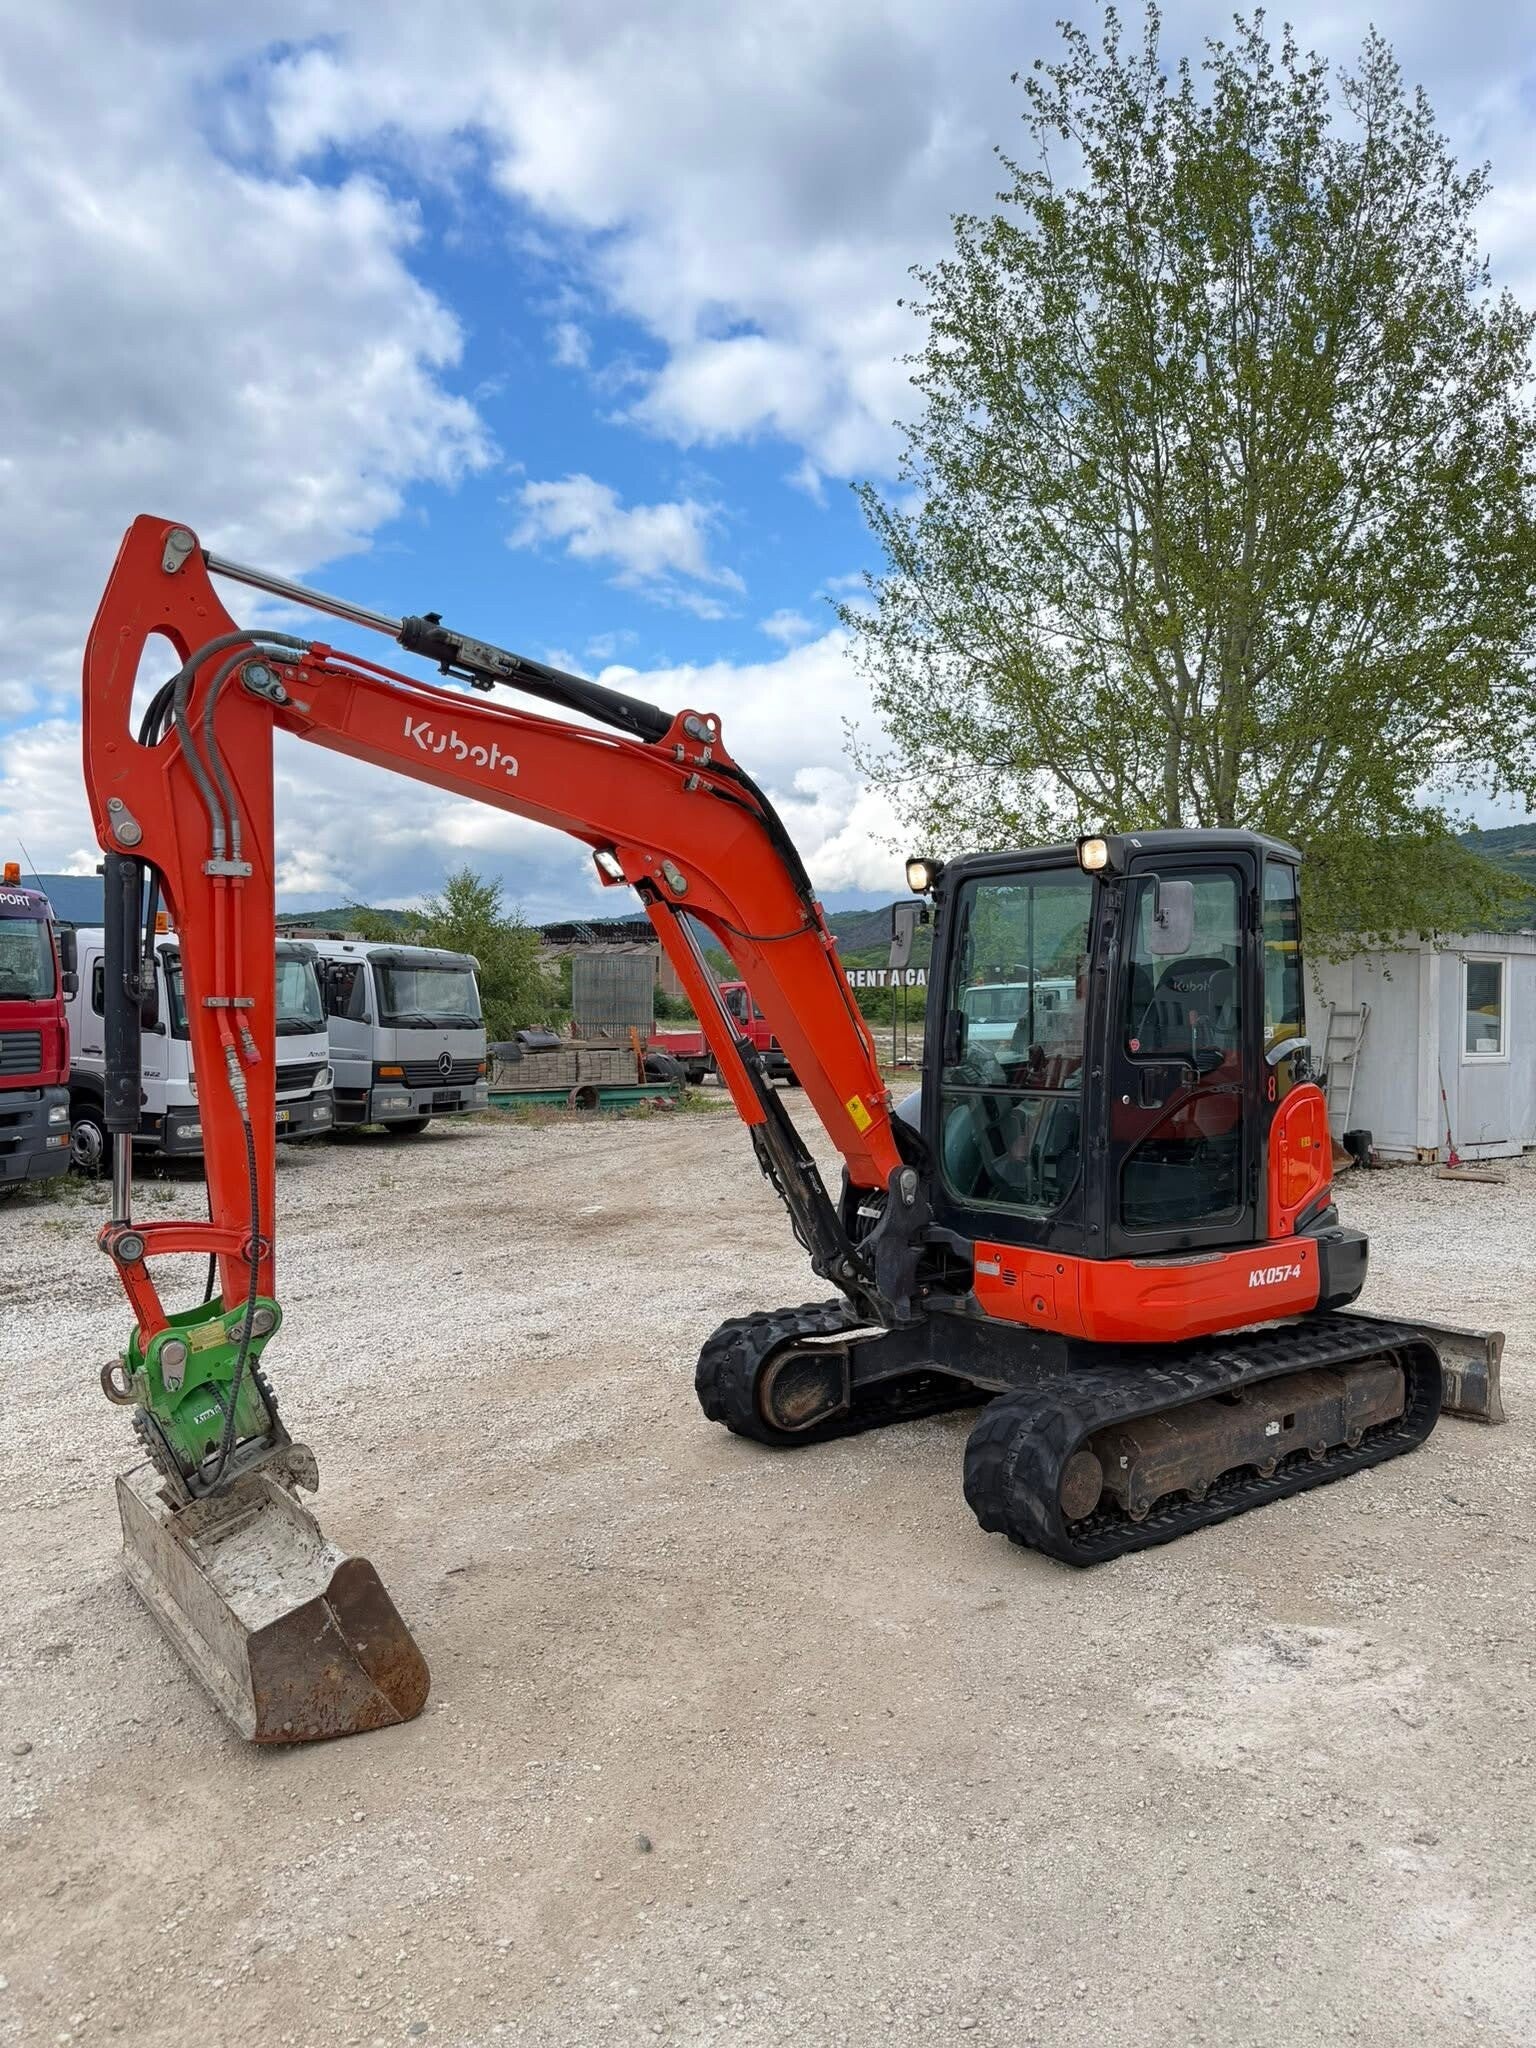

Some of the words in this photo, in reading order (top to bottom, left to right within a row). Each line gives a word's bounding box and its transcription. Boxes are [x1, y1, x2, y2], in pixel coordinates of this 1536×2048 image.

[404, 716, 518, 776] Kubota
[846, 970, 887, 987] RENT
[891, 969, 901, 986] A
[905, 968, 931, 986] CA
[1249, 1264, 1301, 1288] KX057-4
